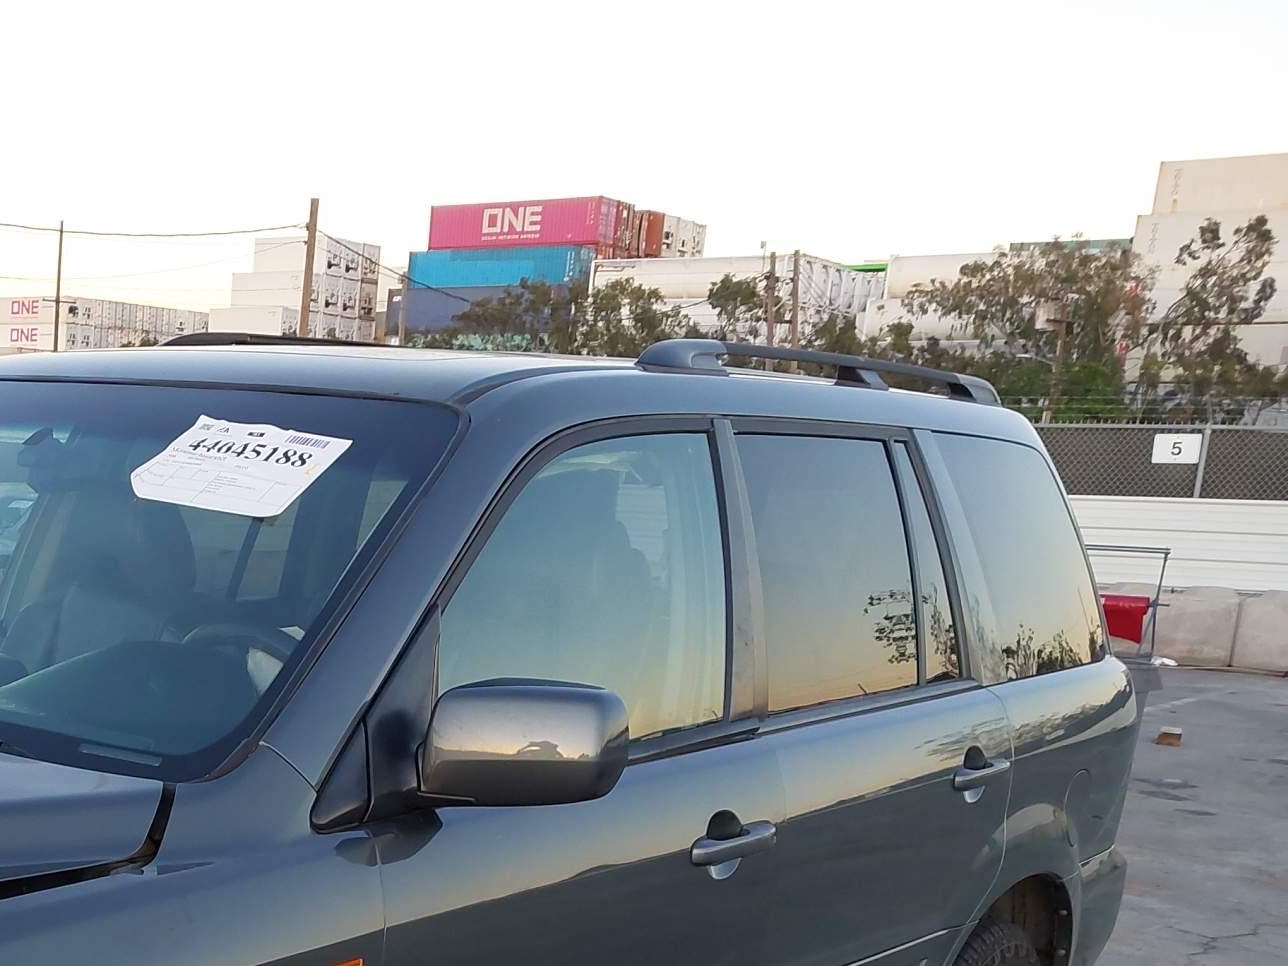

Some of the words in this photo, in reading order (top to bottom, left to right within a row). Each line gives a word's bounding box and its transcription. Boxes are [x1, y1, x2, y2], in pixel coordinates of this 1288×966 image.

[481, 205, 543, 233] ONE
[11, 300, 40, 315] ONE
[10, 328, 38, 342] ONE
[188, 437, 313, 468] 44045188
[1170, 441, 1183, 456] 5
